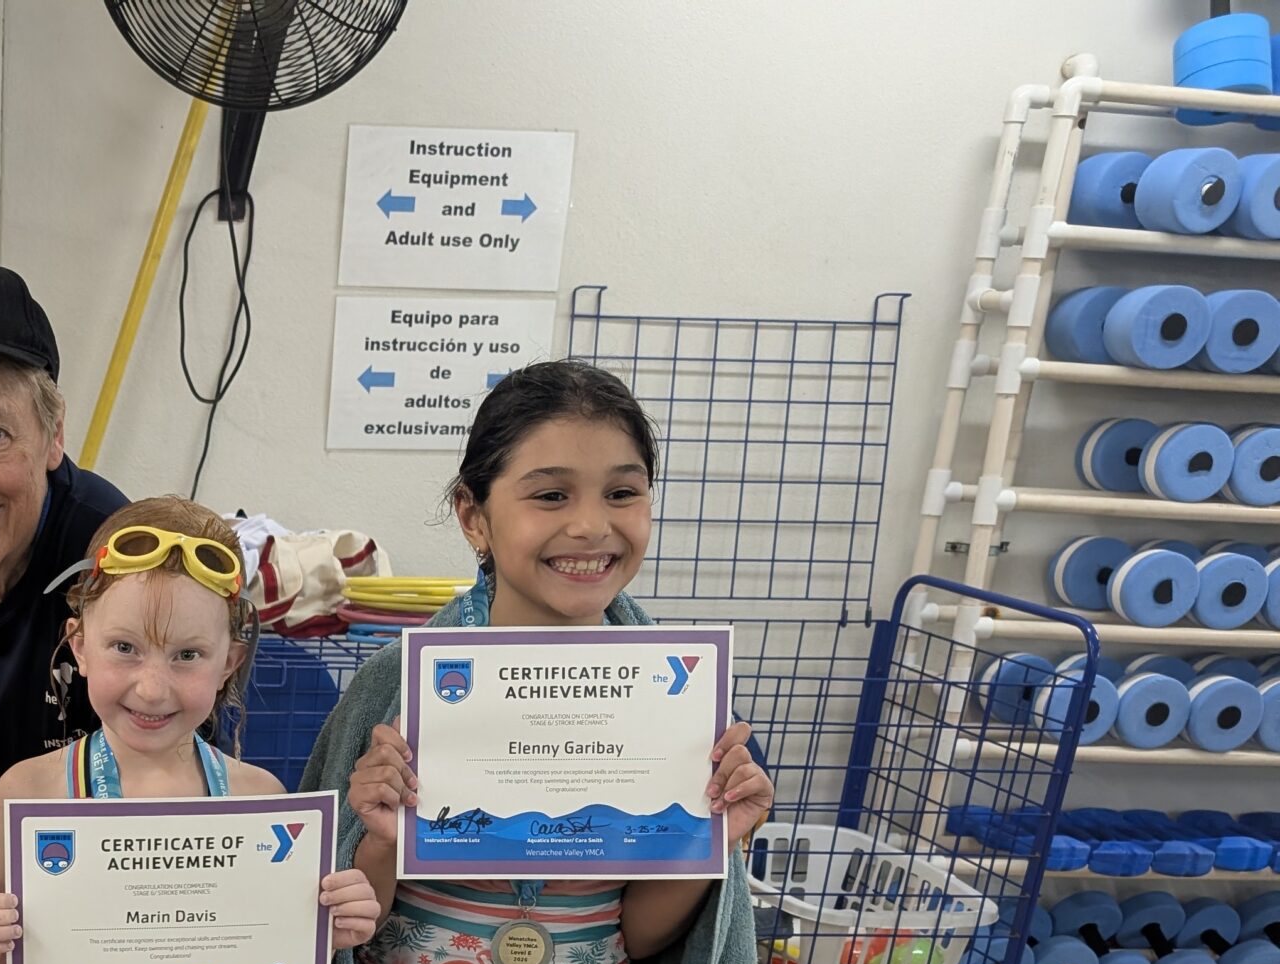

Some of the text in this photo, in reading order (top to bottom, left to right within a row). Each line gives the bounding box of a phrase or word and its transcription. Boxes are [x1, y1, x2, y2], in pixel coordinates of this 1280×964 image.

[409, 140, 512, 158] Instruction
[408, 170, 508, 188] Equipment
[442, 202, 475, 217] and
[385, 231, 520, 252] Adult use Only
[391, 310, 499, 328] Equipo para
[365, 338, 520, 356] instrucción y uso
[430, 365, 451, 380] de
[404, 395, 471, 409] adultos
[499, 666, 640, 680] CERTIFICATE OF
[653, 674, 668, 683] the
[46, 691, 57, 704] he
[505, 685, 633, 699] ACHIEVEMENT
[509, 741, 624, 758] Elenny Garibay
[92, 752, 109, 798] GET MOR
[101, 836, 244, 852] CERTIFICATE OF
[257, 843, 272, 851] the
[564, 849, 583, 857] Valley
[107, 855, 237, 870] ACHIEVEMENT
[126, 910, 216, 924] Marin Davis
